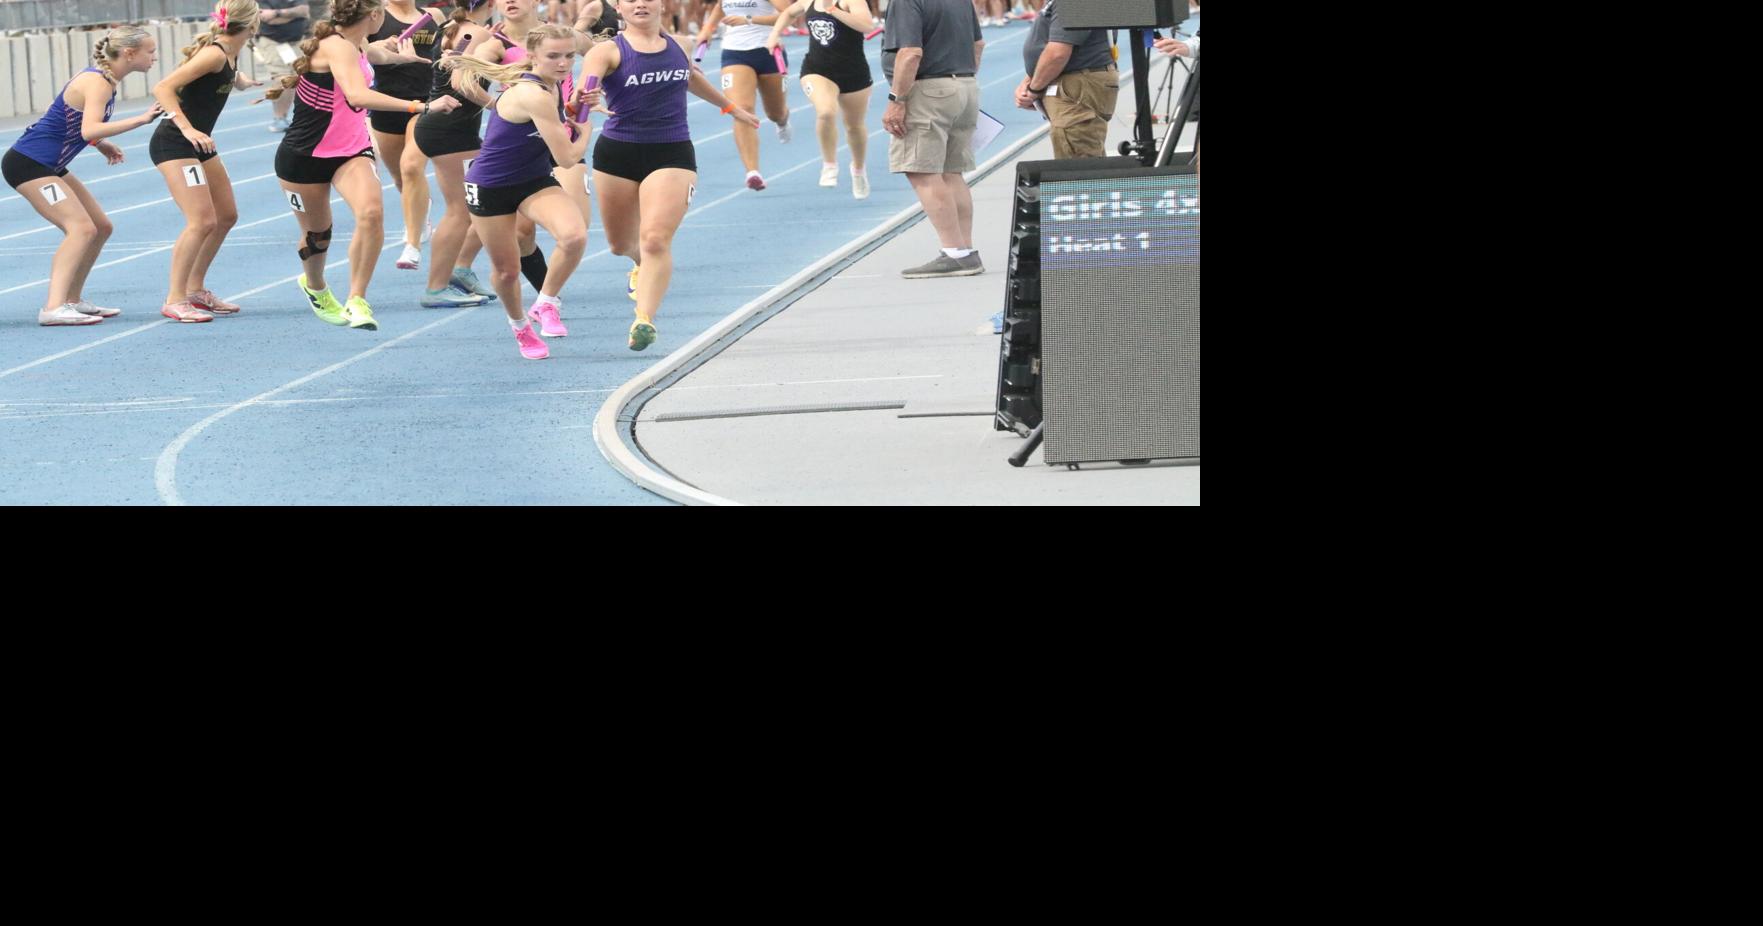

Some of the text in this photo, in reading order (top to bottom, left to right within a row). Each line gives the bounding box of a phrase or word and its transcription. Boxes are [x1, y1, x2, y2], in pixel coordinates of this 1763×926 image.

[189, 166, 200, 184] 1
[43, 184, 58, 202] 7
[290, 193, 301, 210] 4
[1049, 191, 1141, 221] Girls
[1049, 232, 1149, 252] Heat 1
